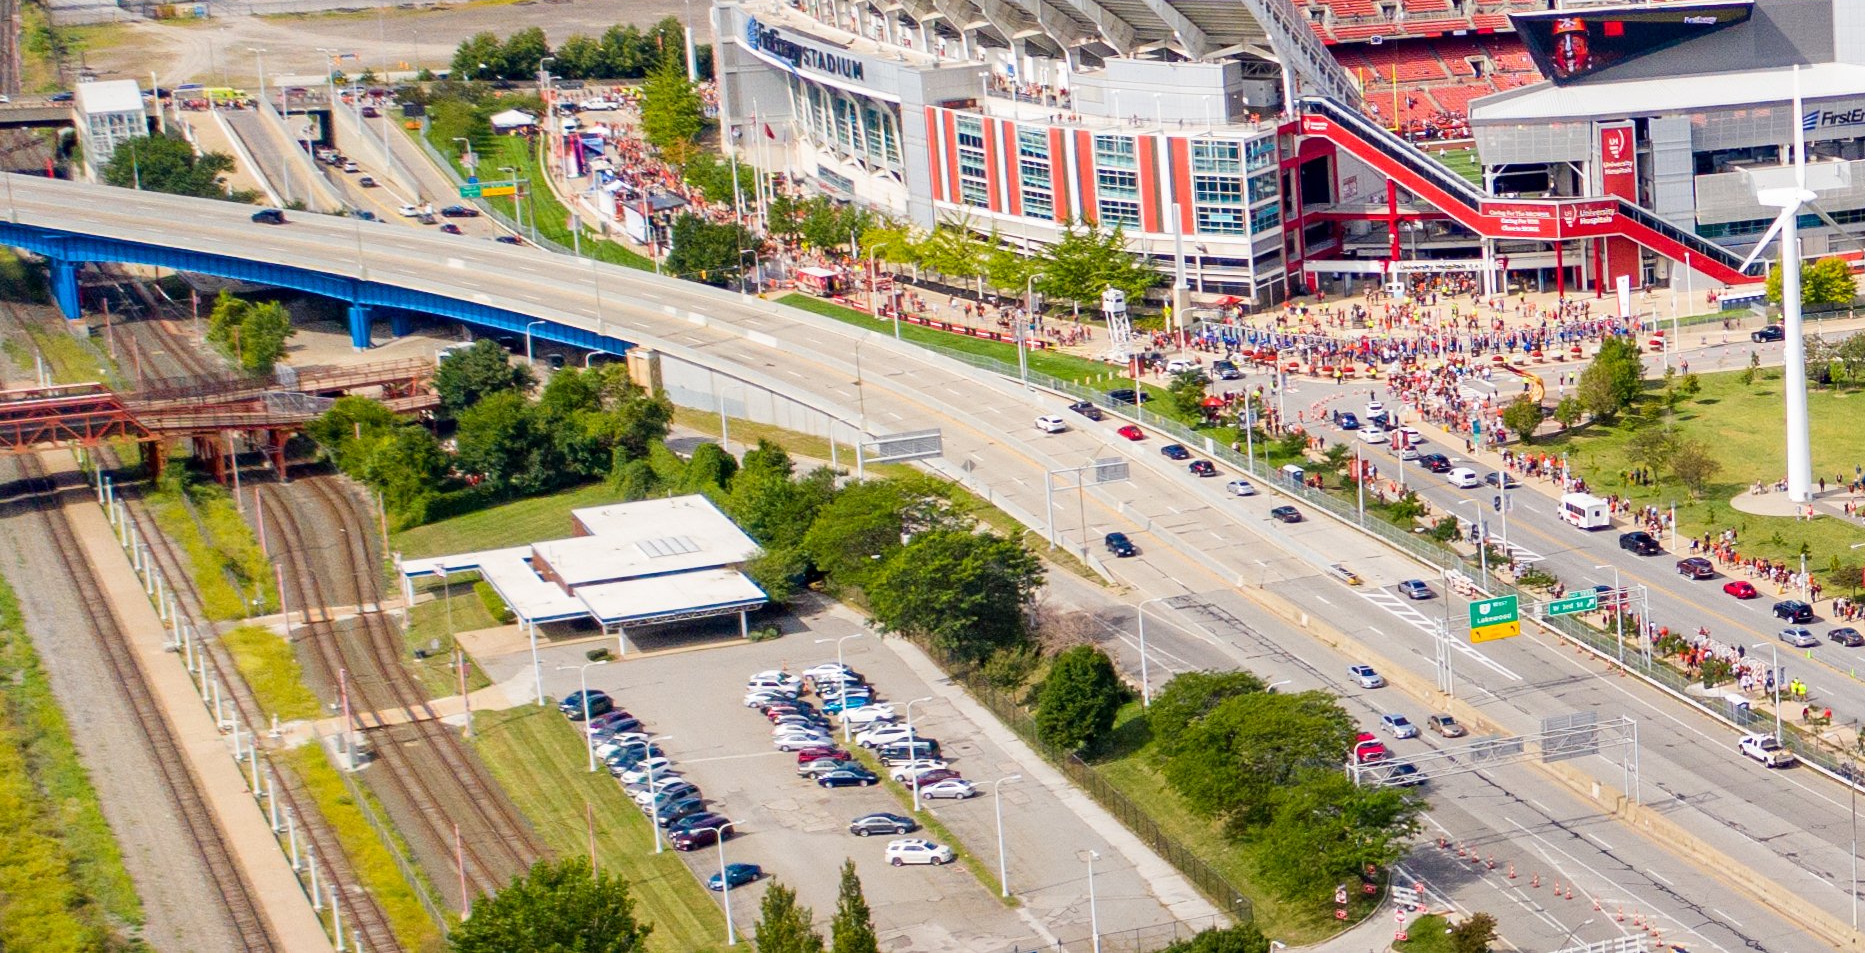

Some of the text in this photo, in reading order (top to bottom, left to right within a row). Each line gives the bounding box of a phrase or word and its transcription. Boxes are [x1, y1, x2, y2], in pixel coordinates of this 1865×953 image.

[803, 47, 864, 81] STADIUM
[1579, 208, 1616, 217] University
[1580, 215, 1613, 225] Hospitals
[1477, 612, 1512, 624] Lakewood
